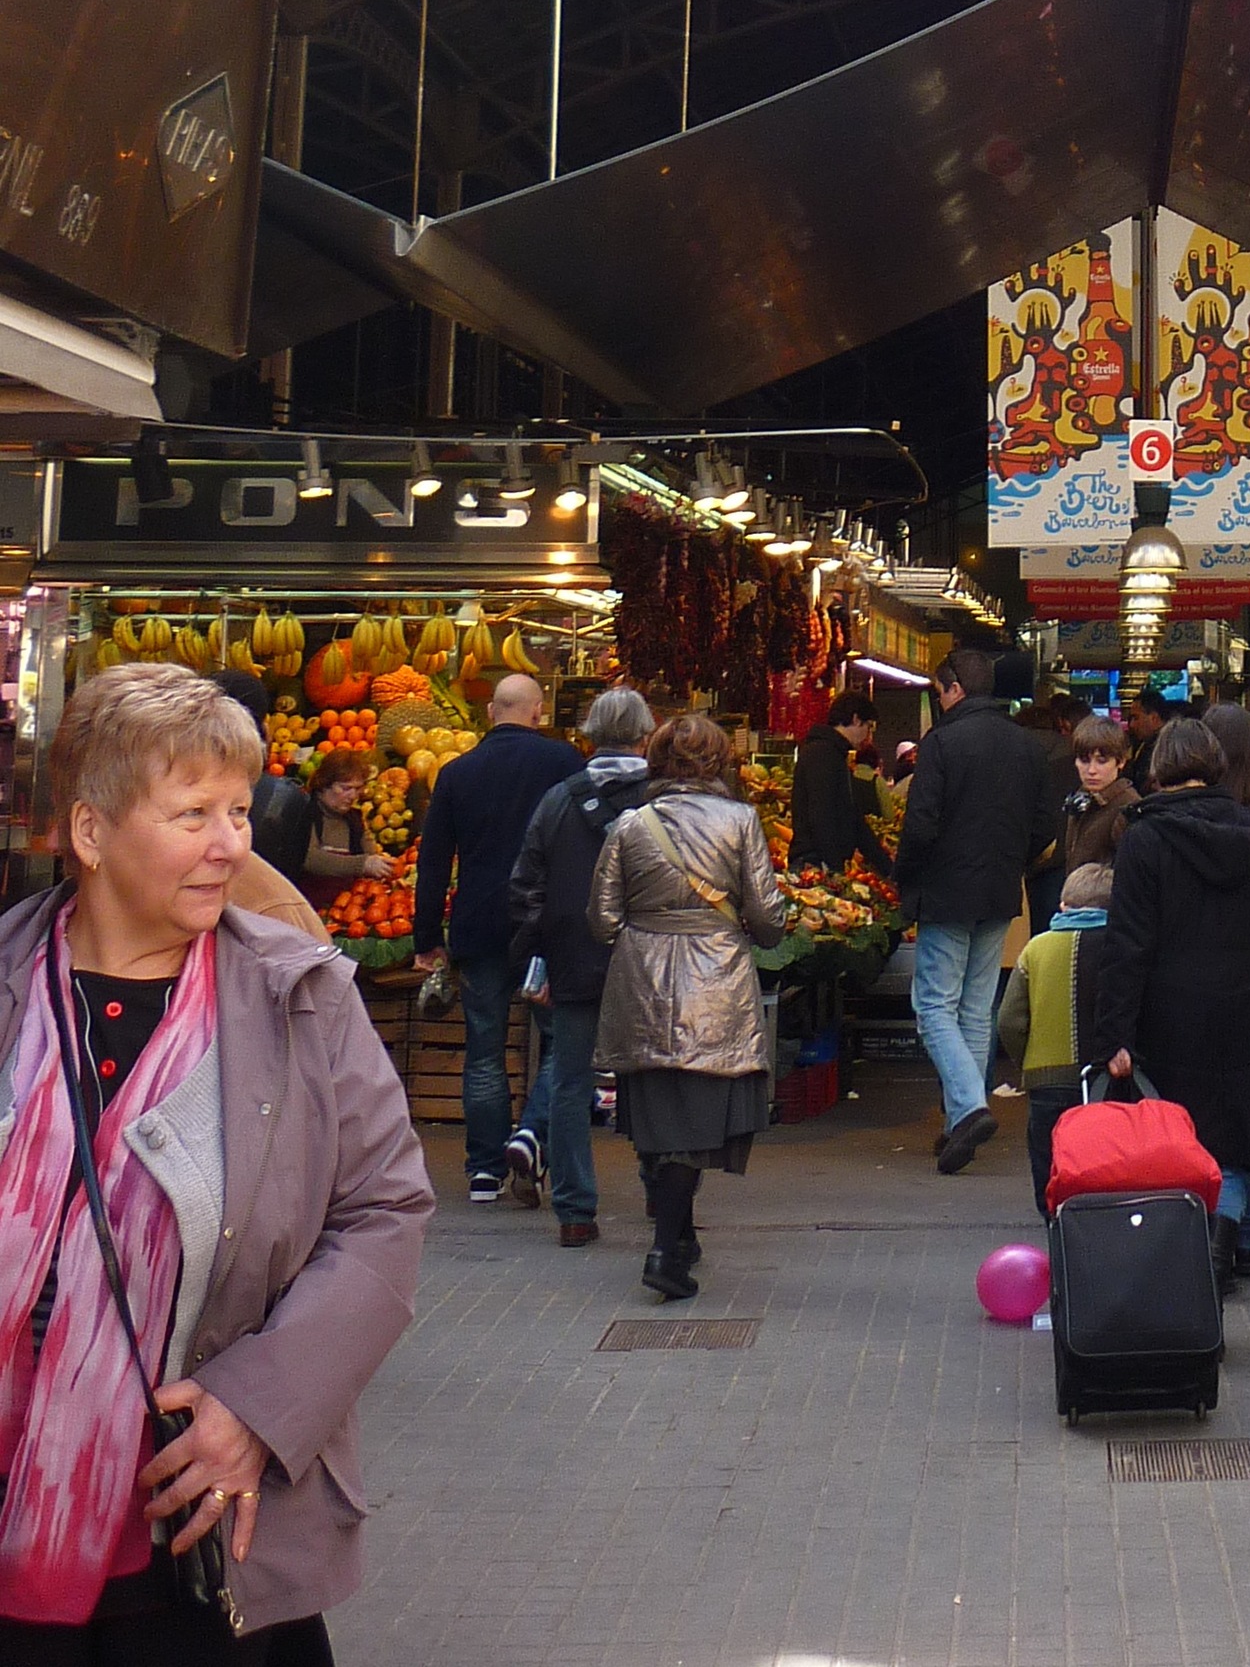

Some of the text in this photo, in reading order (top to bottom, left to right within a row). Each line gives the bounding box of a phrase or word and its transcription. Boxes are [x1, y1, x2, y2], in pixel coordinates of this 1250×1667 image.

[1083, 362, 1120, 374] Estrella
[1142, 436, 1160, 465] 6
[1072, 467, 1121, 495] The
[115, 477, 531, 528] PONS
[1059, 480, 1121, 516] Beer
